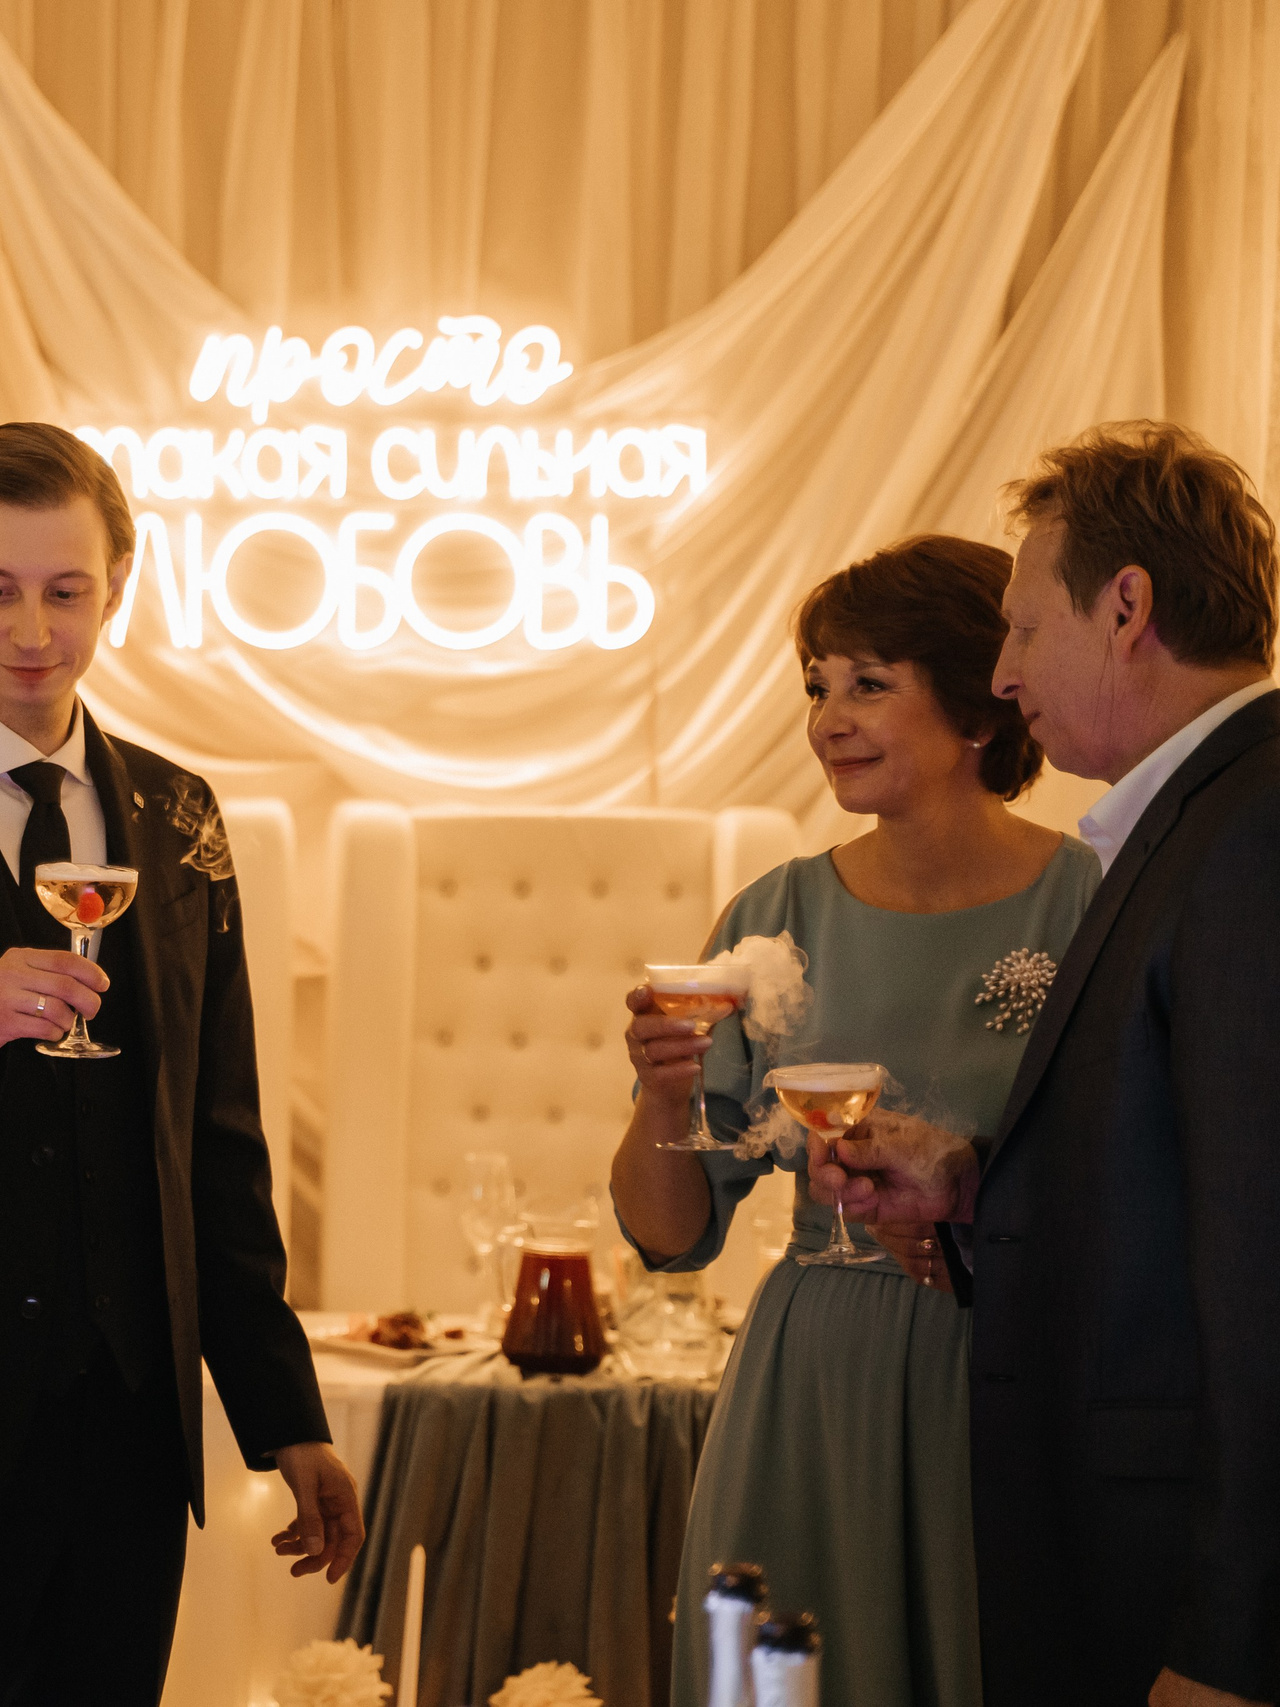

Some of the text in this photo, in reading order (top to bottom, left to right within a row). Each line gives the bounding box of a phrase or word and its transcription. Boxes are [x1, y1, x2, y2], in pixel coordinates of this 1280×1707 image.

[190, 316, 572, 425] просто
[371, 425, 707, 500] сильная
[109, 512, 655, 650] ЛЮБОВЬ
